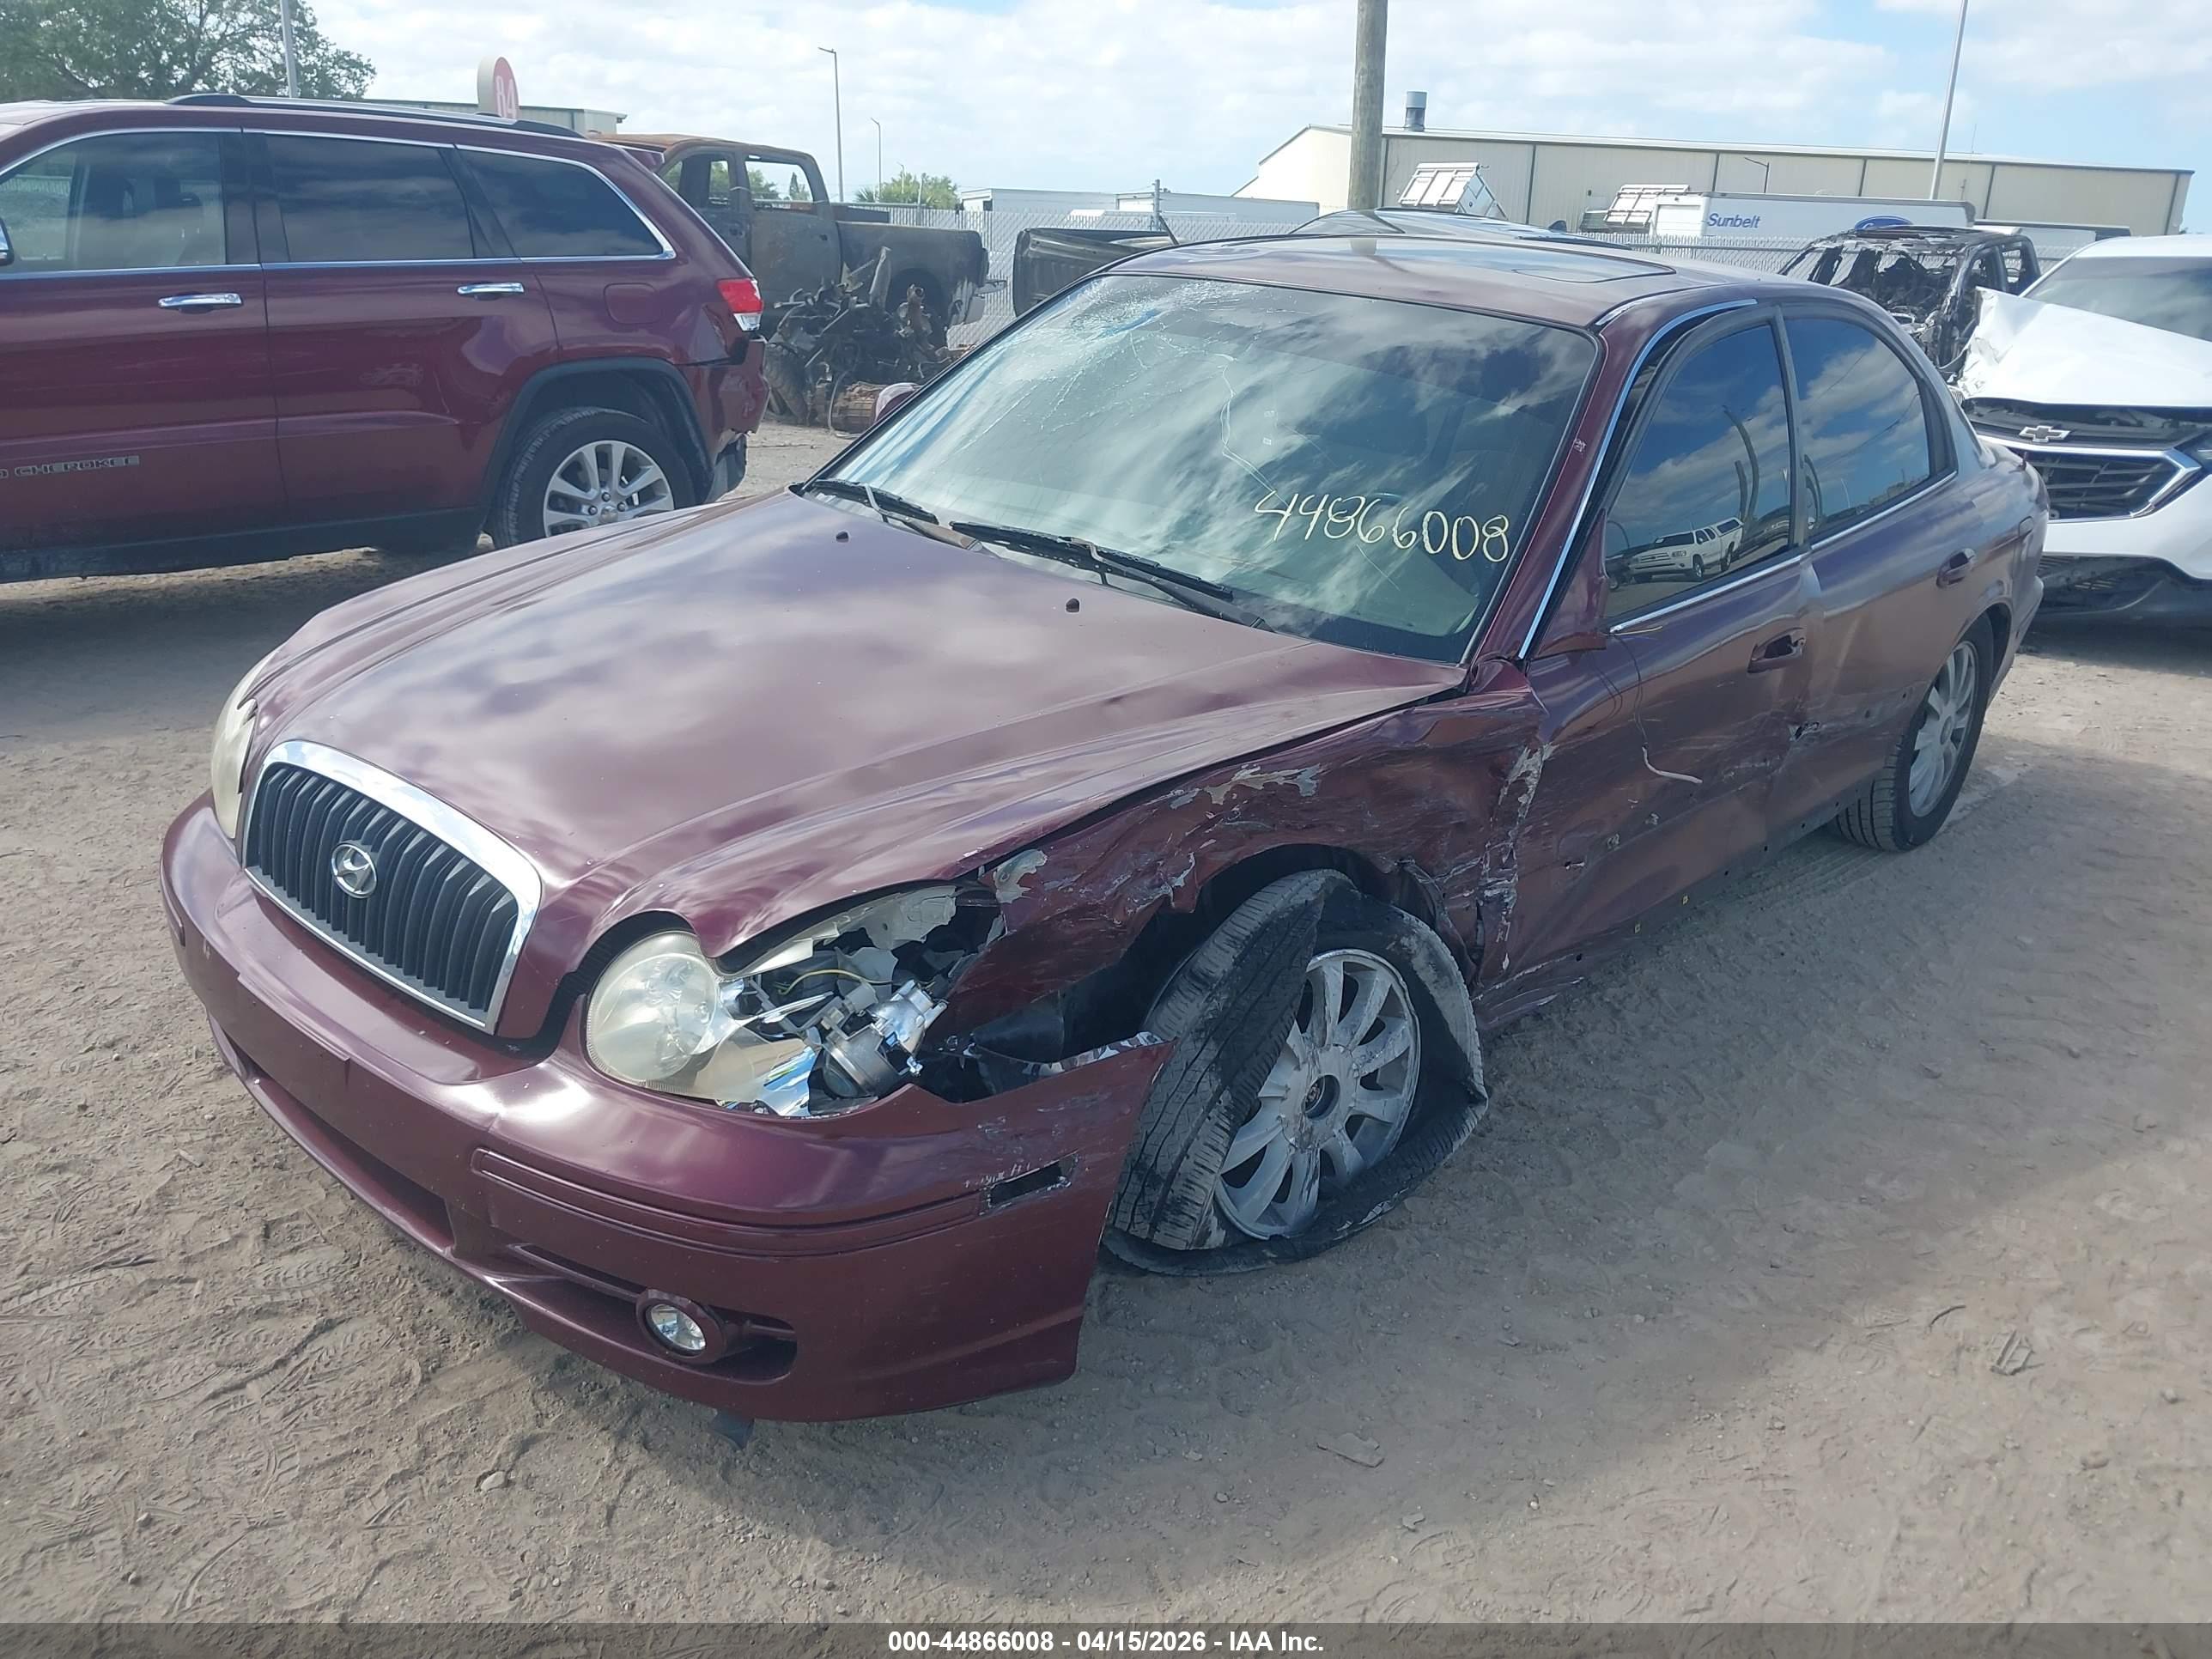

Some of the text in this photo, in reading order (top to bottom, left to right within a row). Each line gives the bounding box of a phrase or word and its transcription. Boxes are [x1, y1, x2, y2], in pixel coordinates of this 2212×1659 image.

[1707, 213, 1760, 228] Sunbelt
[15, 455, 140, 477] CHEROKEE
[1255, 489, 1509, 562] 44866008
